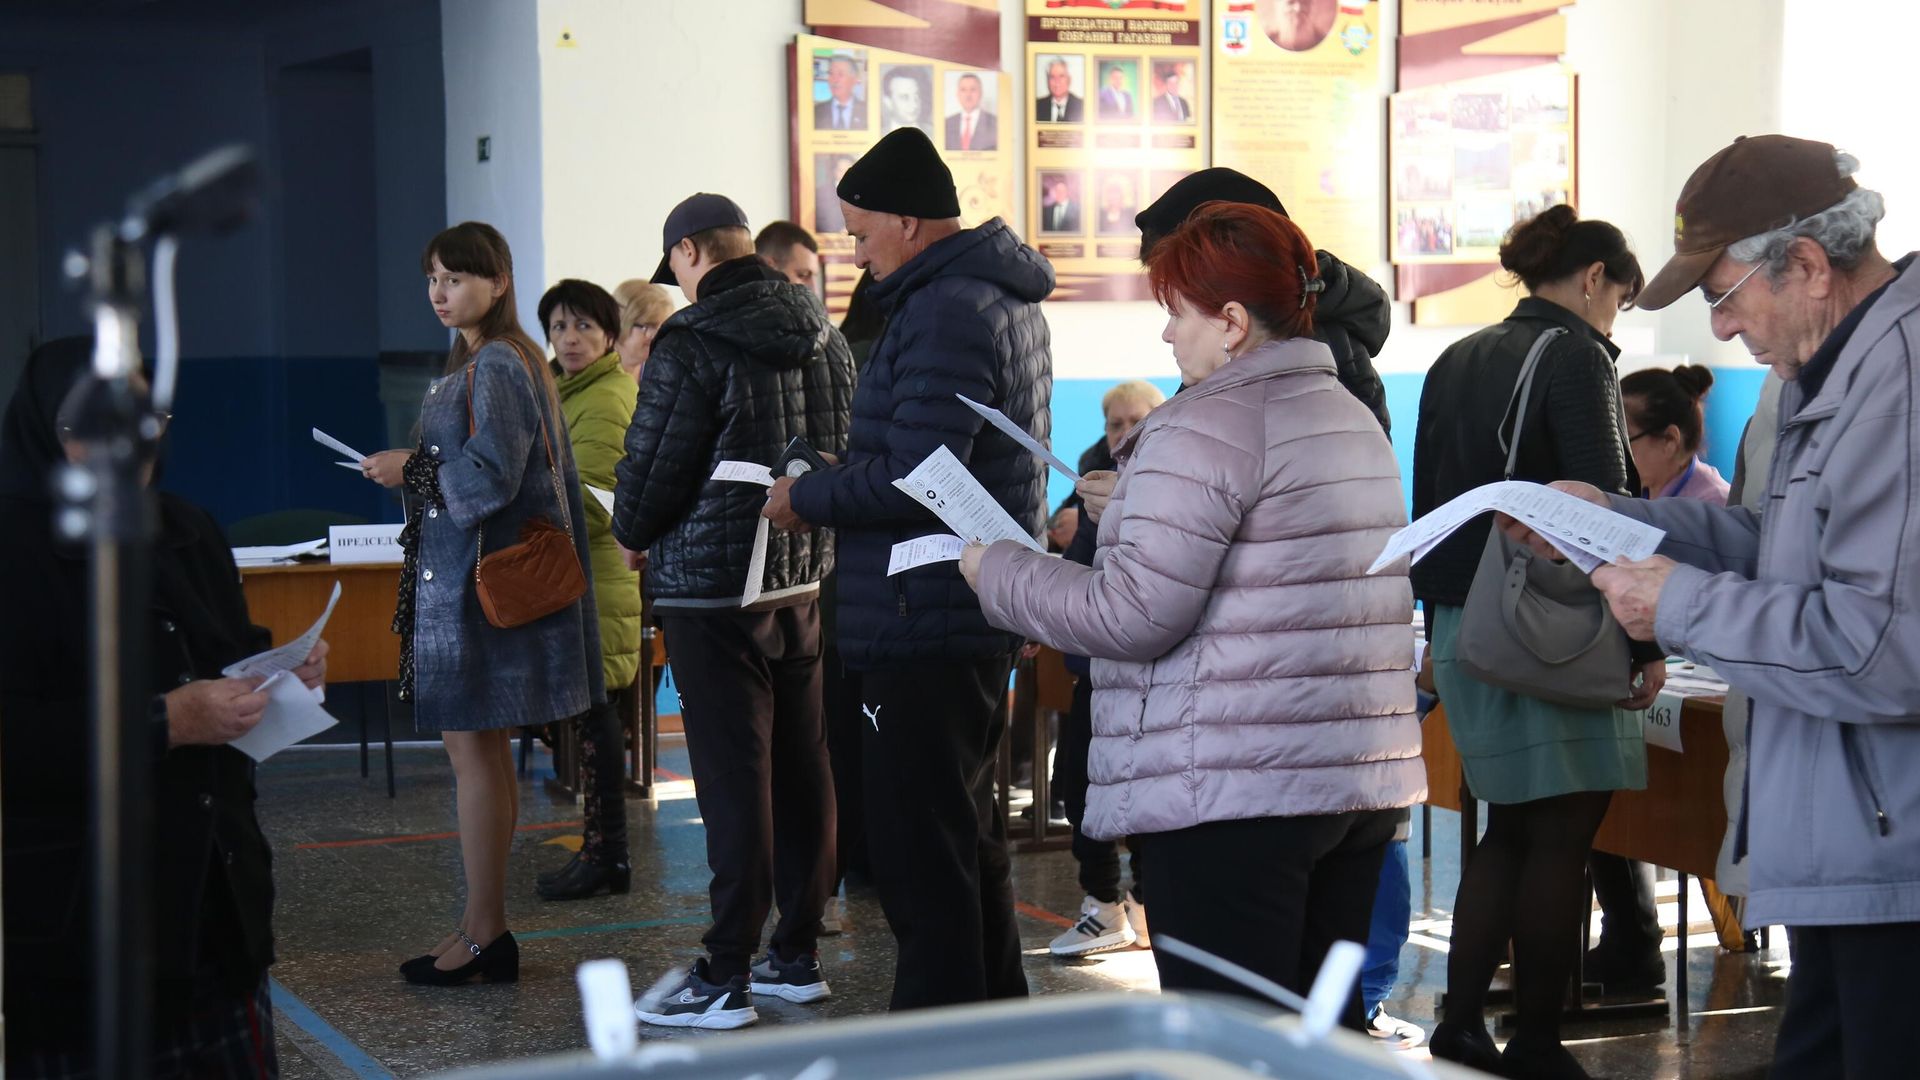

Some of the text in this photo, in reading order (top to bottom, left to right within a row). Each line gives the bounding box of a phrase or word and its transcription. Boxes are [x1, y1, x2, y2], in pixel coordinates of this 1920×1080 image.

[1040, 17, 1188, 33] ПРЕДСЕДАТЕЛИ НАРОДНОГО
[1057, 30, 1172, 44] СОБРАНИЯ ГАГАУЗИИ
[1647, 706, 1671, 727] 463
